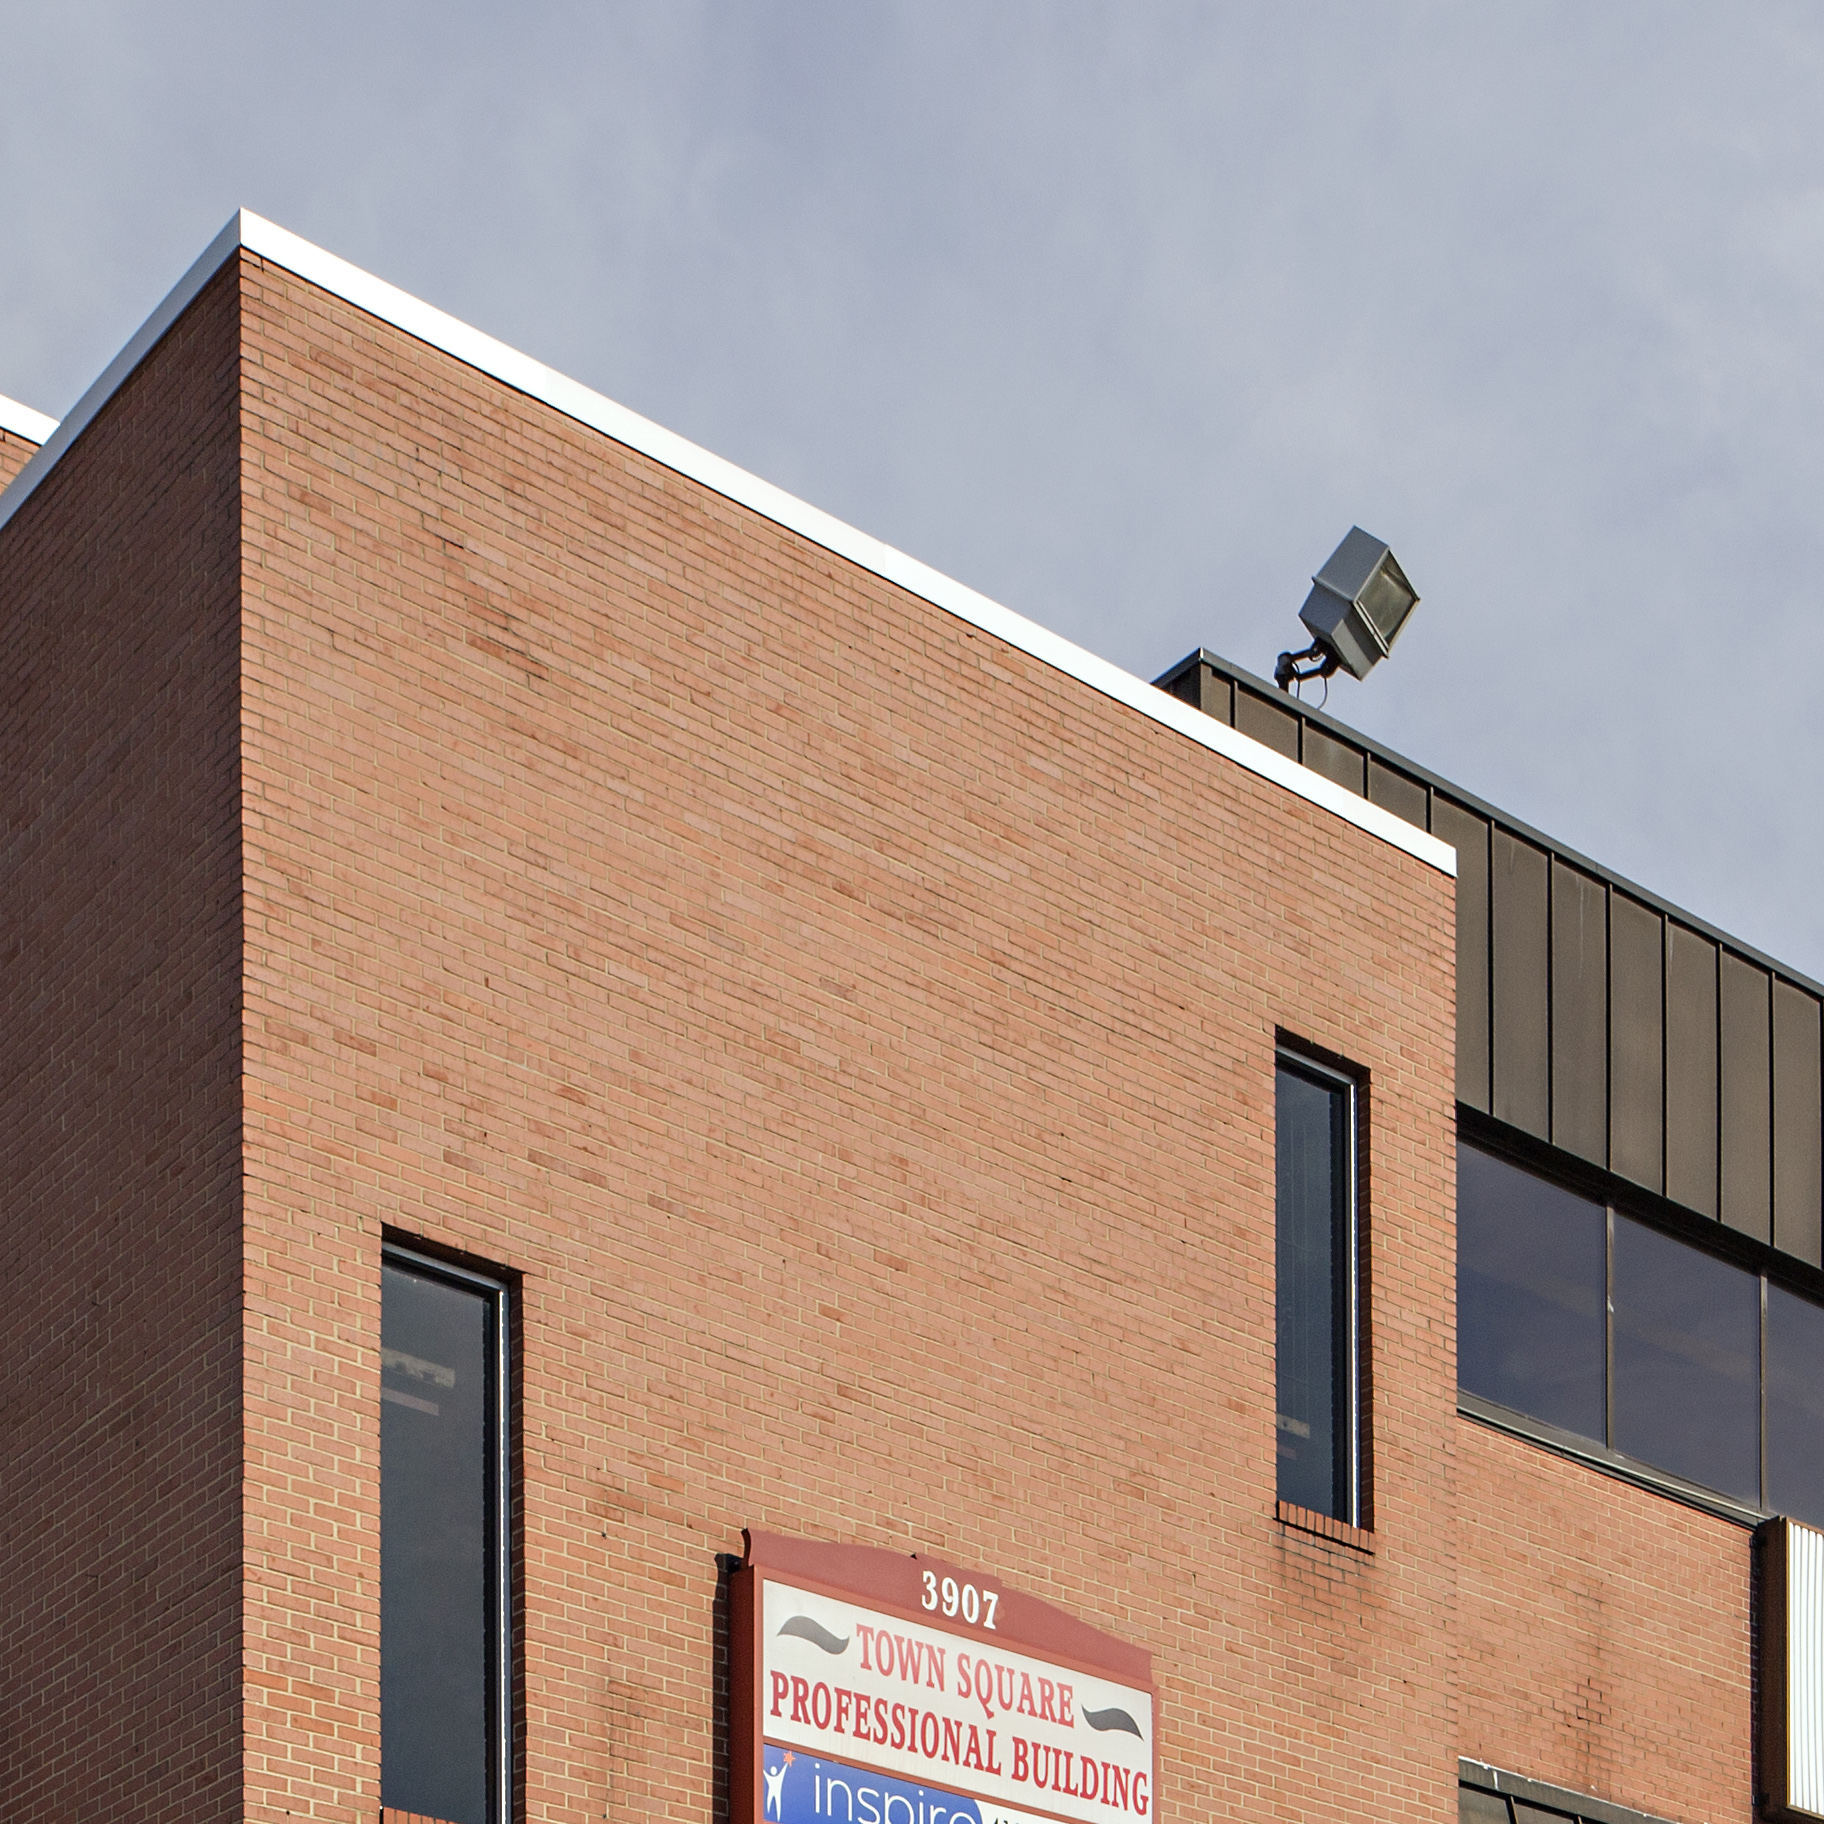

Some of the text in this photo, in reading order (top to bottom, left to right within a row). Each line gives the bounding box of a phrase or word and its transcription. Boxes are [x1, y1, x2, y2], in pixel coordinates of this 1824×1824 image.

[922, 1571, 999, 1630] 3907
[856, 1623, 1074, 1729] TOWN SQUARE
[770, 1670, 1149, 1816] PROFESSIONAL BUILDING
